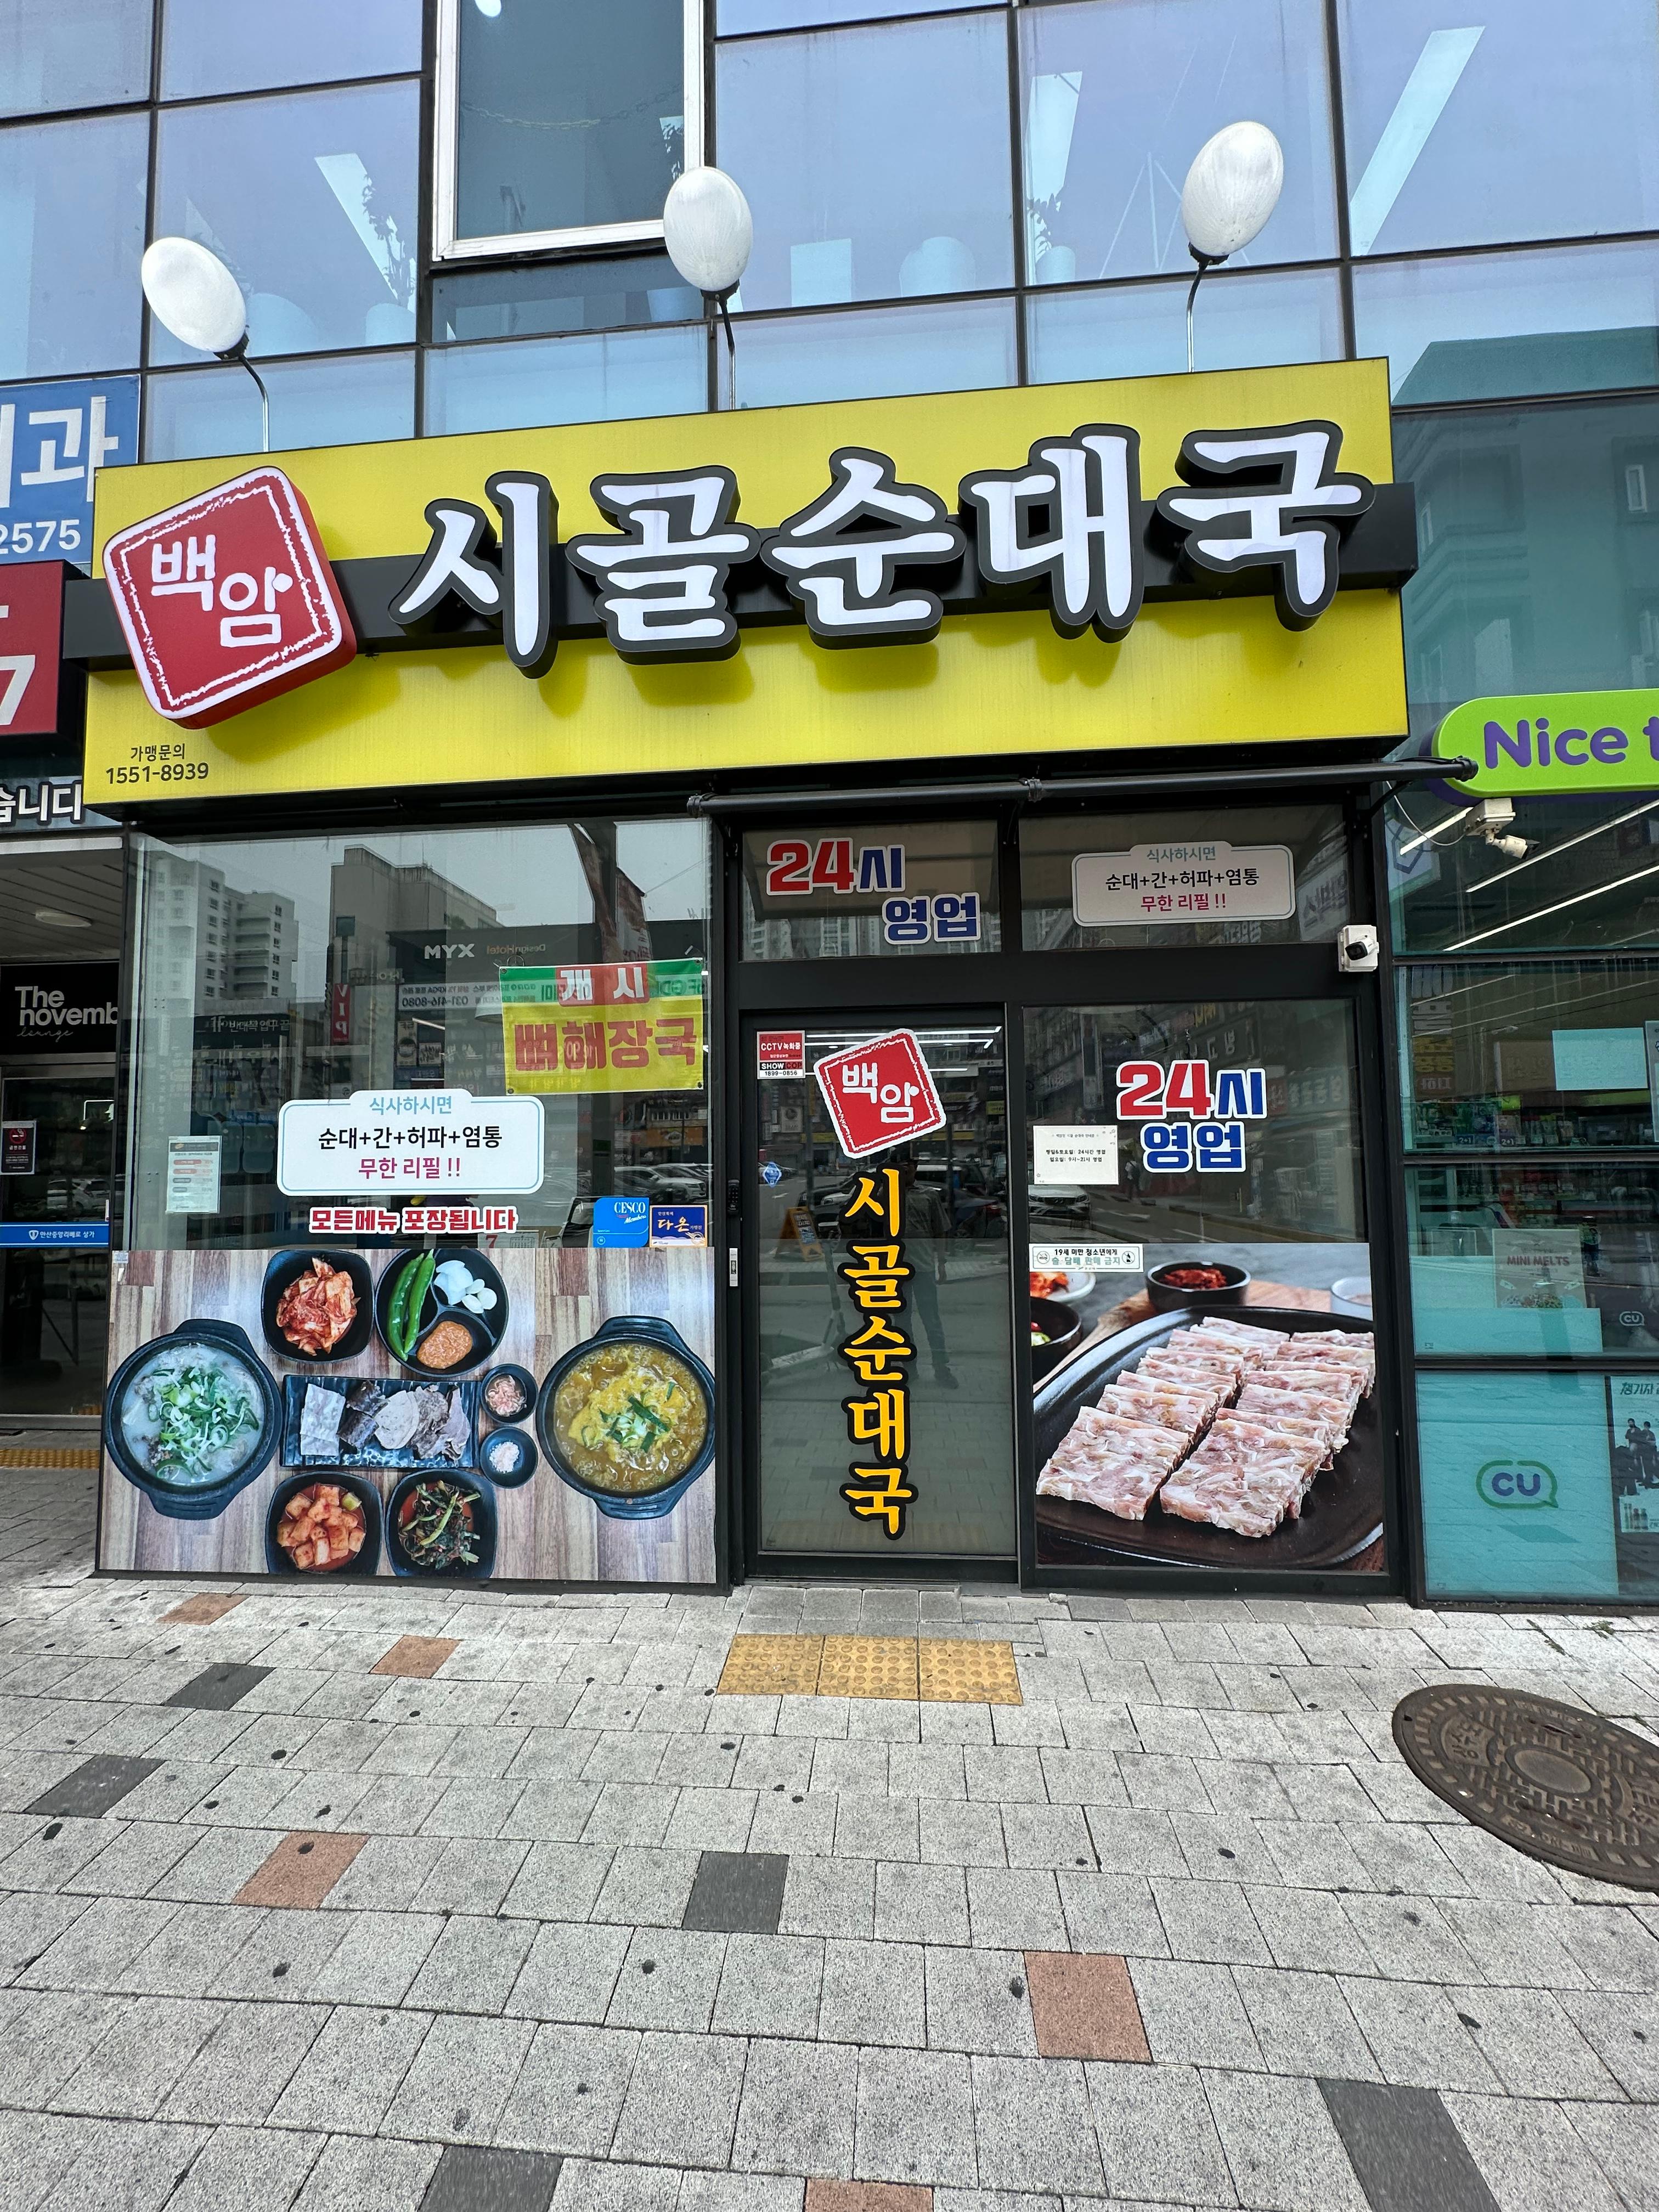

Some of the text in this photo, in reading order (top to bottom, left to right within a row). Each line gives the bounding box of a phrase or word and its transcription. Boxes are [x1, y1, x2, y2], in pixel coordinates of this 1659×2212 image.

[0, 396, 118, 507] 과
[391, 424, 1369, 670] 시골순대국
[151, 535, 293, 646] 백암
[131, 743, 185, 761] 가맹문의
[1483, 718, 1628, 769] Nice
[106, 763, 209, 785] 1551-8939
[768, 839, 904, 894] 24시
[1147, 847, 1215, 862] 식사하시면
[1105, 868, 1260, 890] 순대+간+허파+염통
[1141, 895, 1172, 912] 무한
[1178, 894, 1209, 911] 리필
[884, 894, 979, 943] 영업
[15, 986, 64, 1008] The
[515, 1018, 697, 1071] 뼈해장국
[843, 1063, 919, 1123] 백암
[1118, 1062, 1265, 1118] 24시
[369, 1096, 452, 1115] 식사하시면
[318, 1125, 503, 1150] 순대+간+허파+염통
[1143, 1124, 1244, 1171] 영업
[358, 1158, 397, 1180] 무한
[403, 1156, 440, 1179] 리필
[310, 1207, 517, 1233] 모든메뉴 포장됩니다
[614, 1202, 646, 1214] CESCO
[1507, 1255, 1570, 1267] MINI MELTS
[842, 1166, 915, 1536] 시골순대국
[1492, 1472, 1541, 1497] CU
